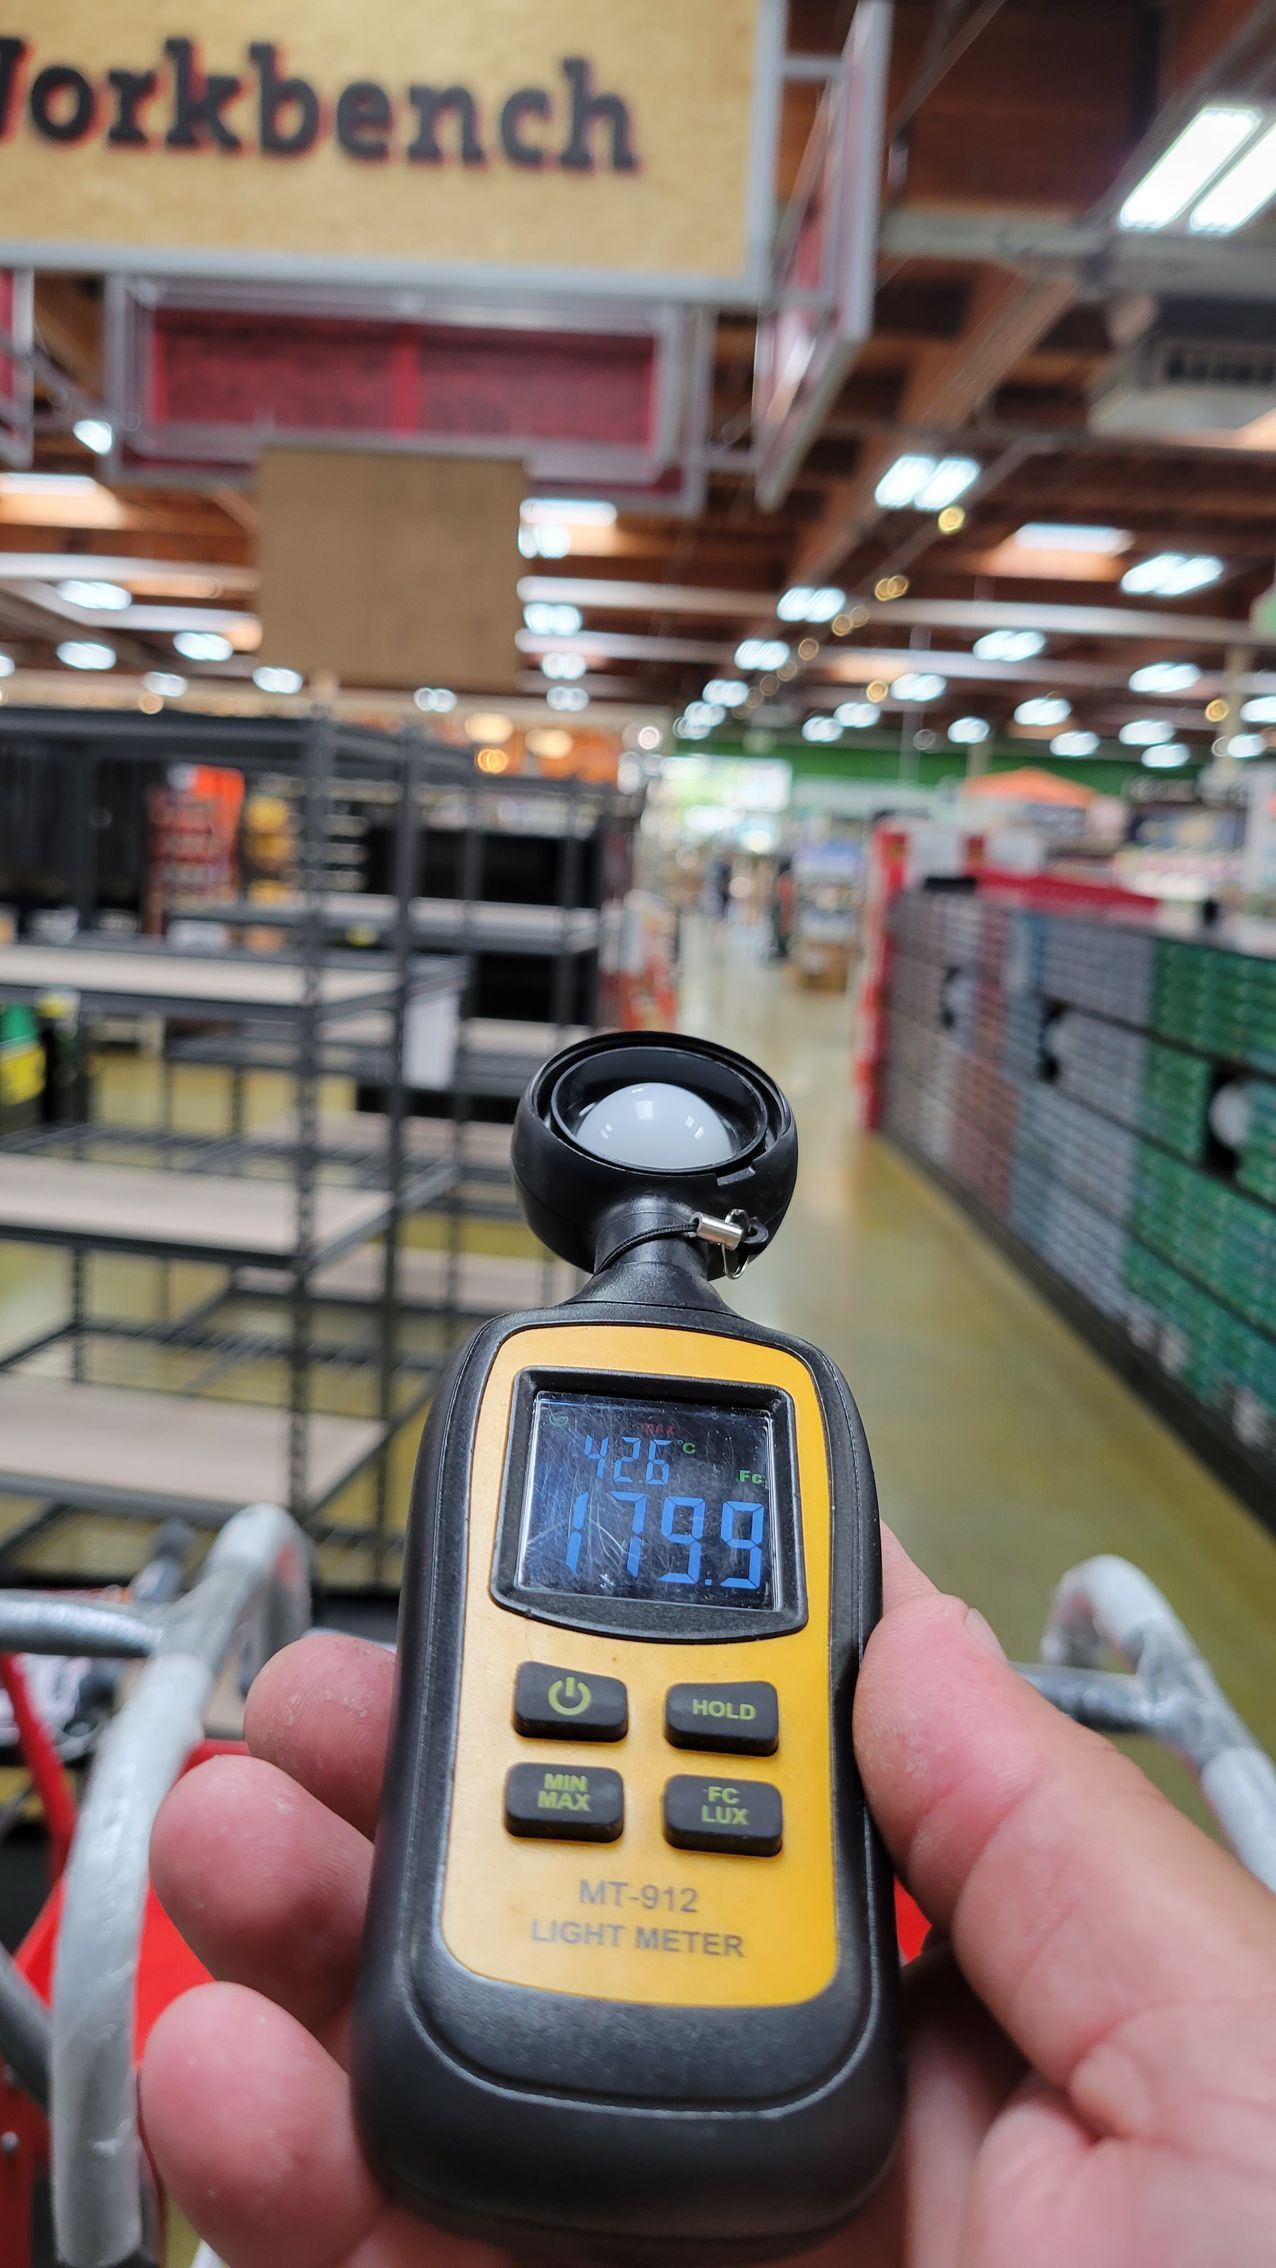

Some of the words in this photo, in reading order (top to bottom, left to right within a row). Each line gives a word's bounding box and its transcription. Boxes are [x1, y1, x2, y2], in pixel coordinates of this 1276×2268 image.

[566, 1491, 764, 1590] 179.9
[693, 1699, 756, 1720] HOLD
[544, 1774, 588, 1792] MIN
[538, 1791, 592, 1811] MAX
[708, 1786, 740, 1804] FC
[702, 1805, 749, 1825] LUX
[578, 1878, 699, 1914] MT-912
[530, 1918, 626, 1949] LIGHT
[635, 1928, 746, 1958] METER
